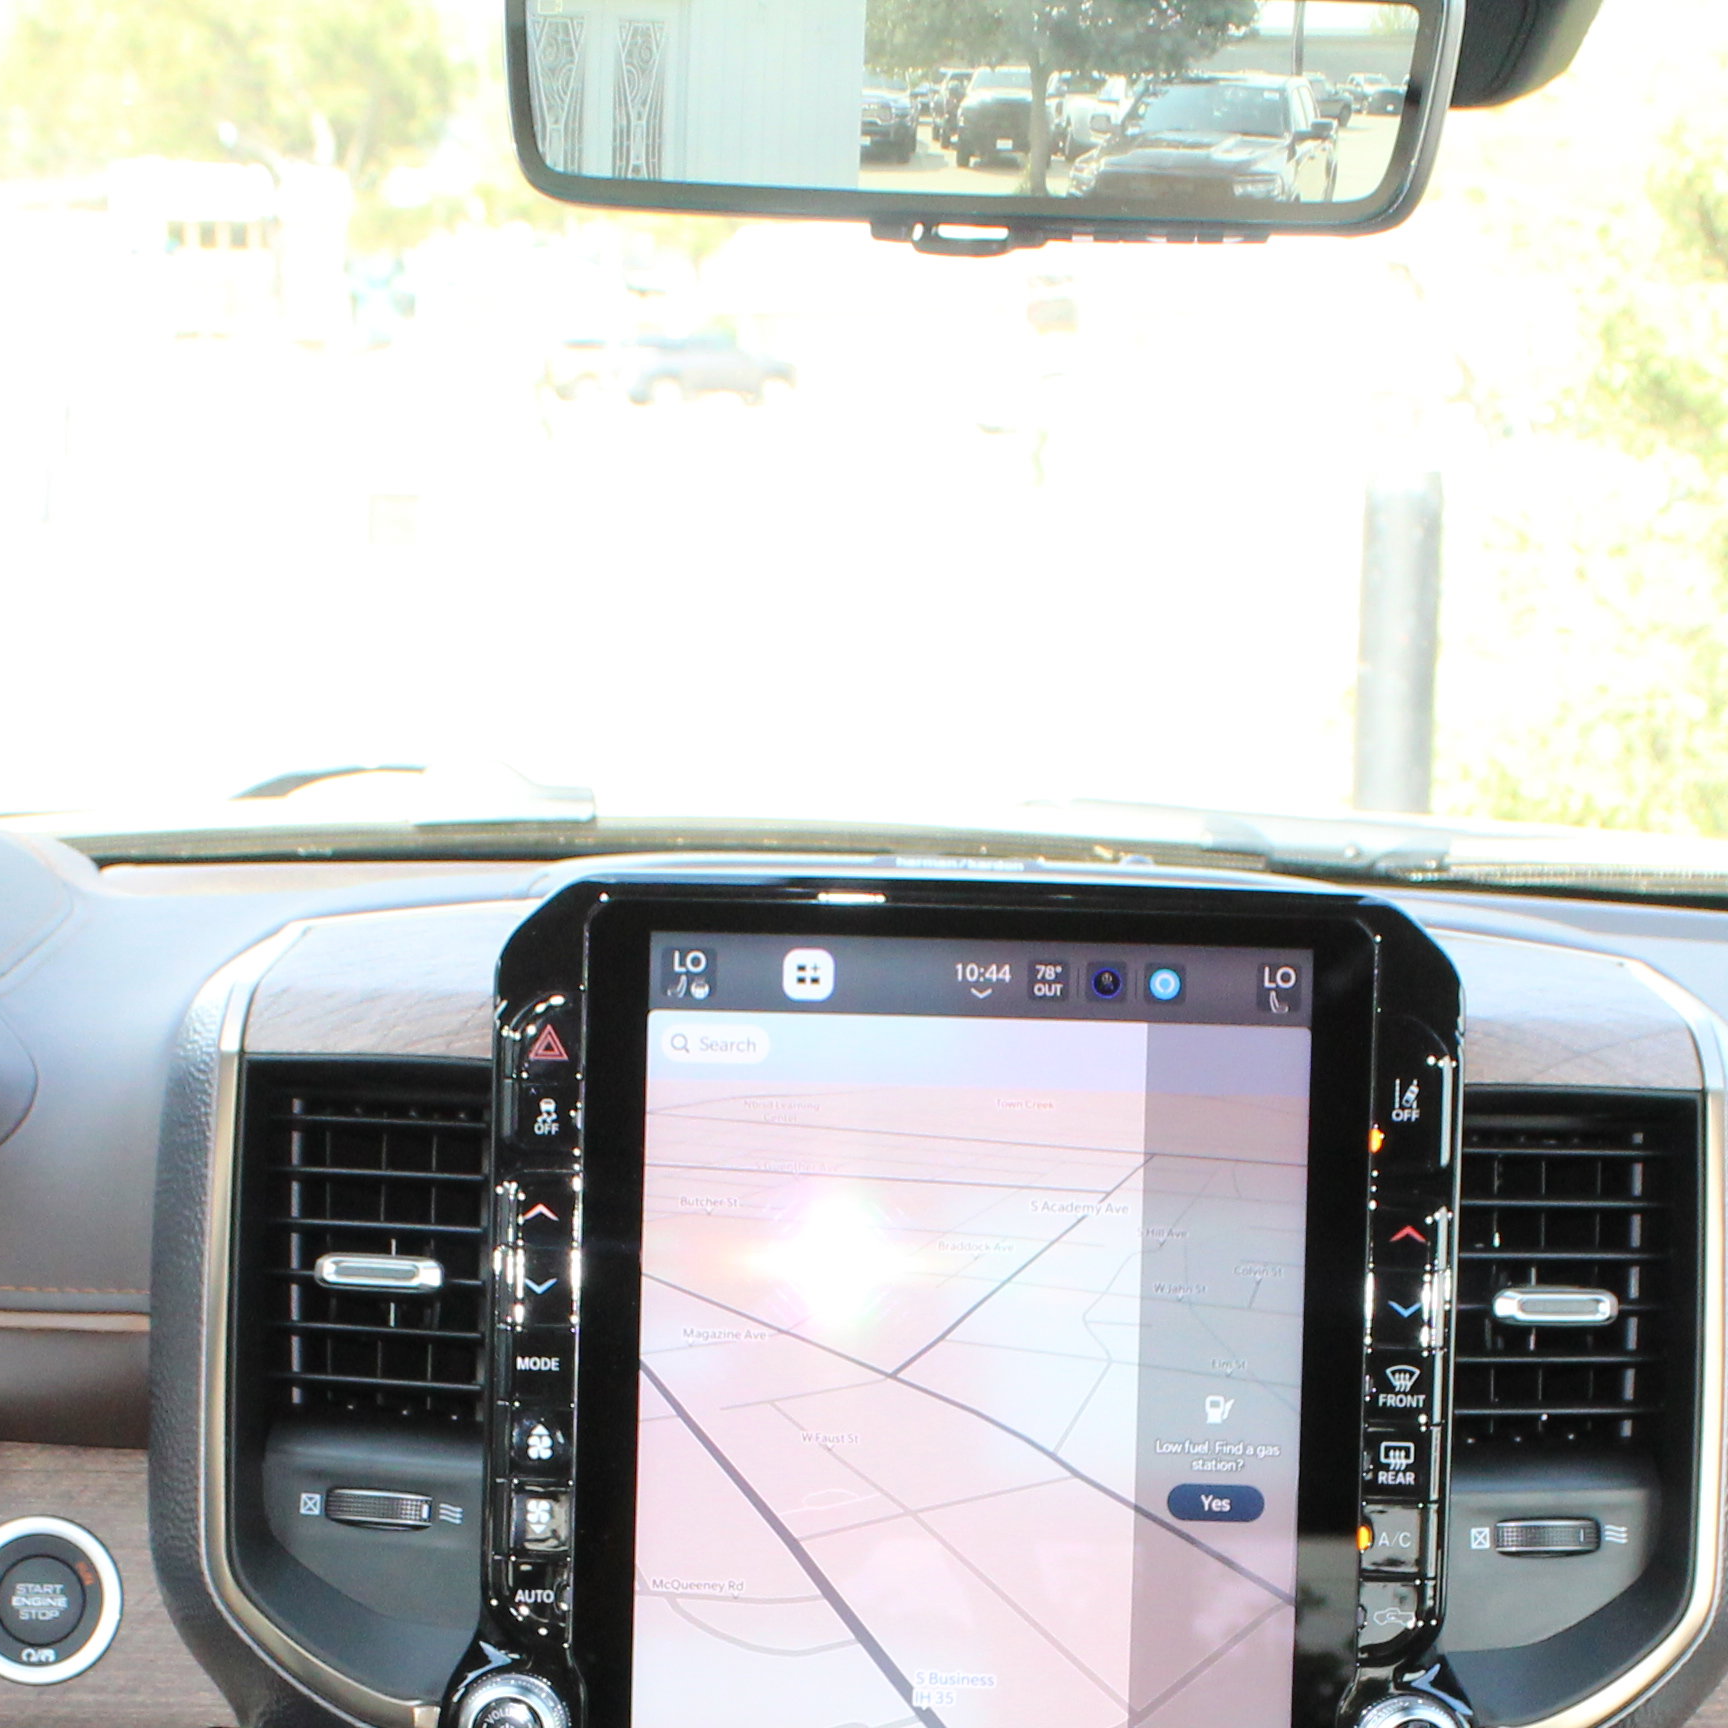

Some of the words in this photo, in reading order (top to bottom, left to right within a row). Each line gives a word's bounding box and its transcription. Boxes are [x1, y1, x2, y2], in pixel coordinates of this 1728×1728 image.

[673, 949, 707, 974] LO
[955, 962, 1012, 983] 10:44
[1263, 966, 1297, 989] LO
[1033, 983, 1063, 997] OUT
[699, 1036, 756, 1053] Search
[1391, 1109, 1420, 1122] OFF
[534, 1123, 559, 1135] OFF
[680, 1196, 724, 1208] Butcher
[1030, 1201, 1039, 1213] S
[1041, 1201, 1103, 1216] Academy
[1105, 1203, 1130, 1214] Ave
[682, 1328, 741, 1342] Magazine
[744, 1329, 767, 1341] Ave
[516, 1356, 560, 1371] MODE
[1378, 1394, 1426, 1408] FRONT
[815, 1433, 844, 1443] Faust
[1156, 1440, 1182, 1453] Low
[1215, 1441, 1242, 1455] Find
[1245, 1445, 1253, 1455] a
[1256, 1446, 1280, 1458] gas
[1191, 1458, 1244, 1471] station?
[1378, 1471, 1415, 1485] REAR
[1200, 1494, 1231, 1511] Yes
[1378, 1532, 1412, 1549] A/C
[15, 1583, 64, 1594] START
[652, 1578, 725, 1593] McQueeney
[728, 1580, 744, 1591] Rd
[11, 1596, 68, 1608] ENGINE
[515, 1589, 555, 1603] AUTO
[18, 1609, 60, 1620] STOP
[915, 1672, 925, 1685] S
[929, 1672, 995, 1687] Business
[936, 1692, 954, 1705] 35
